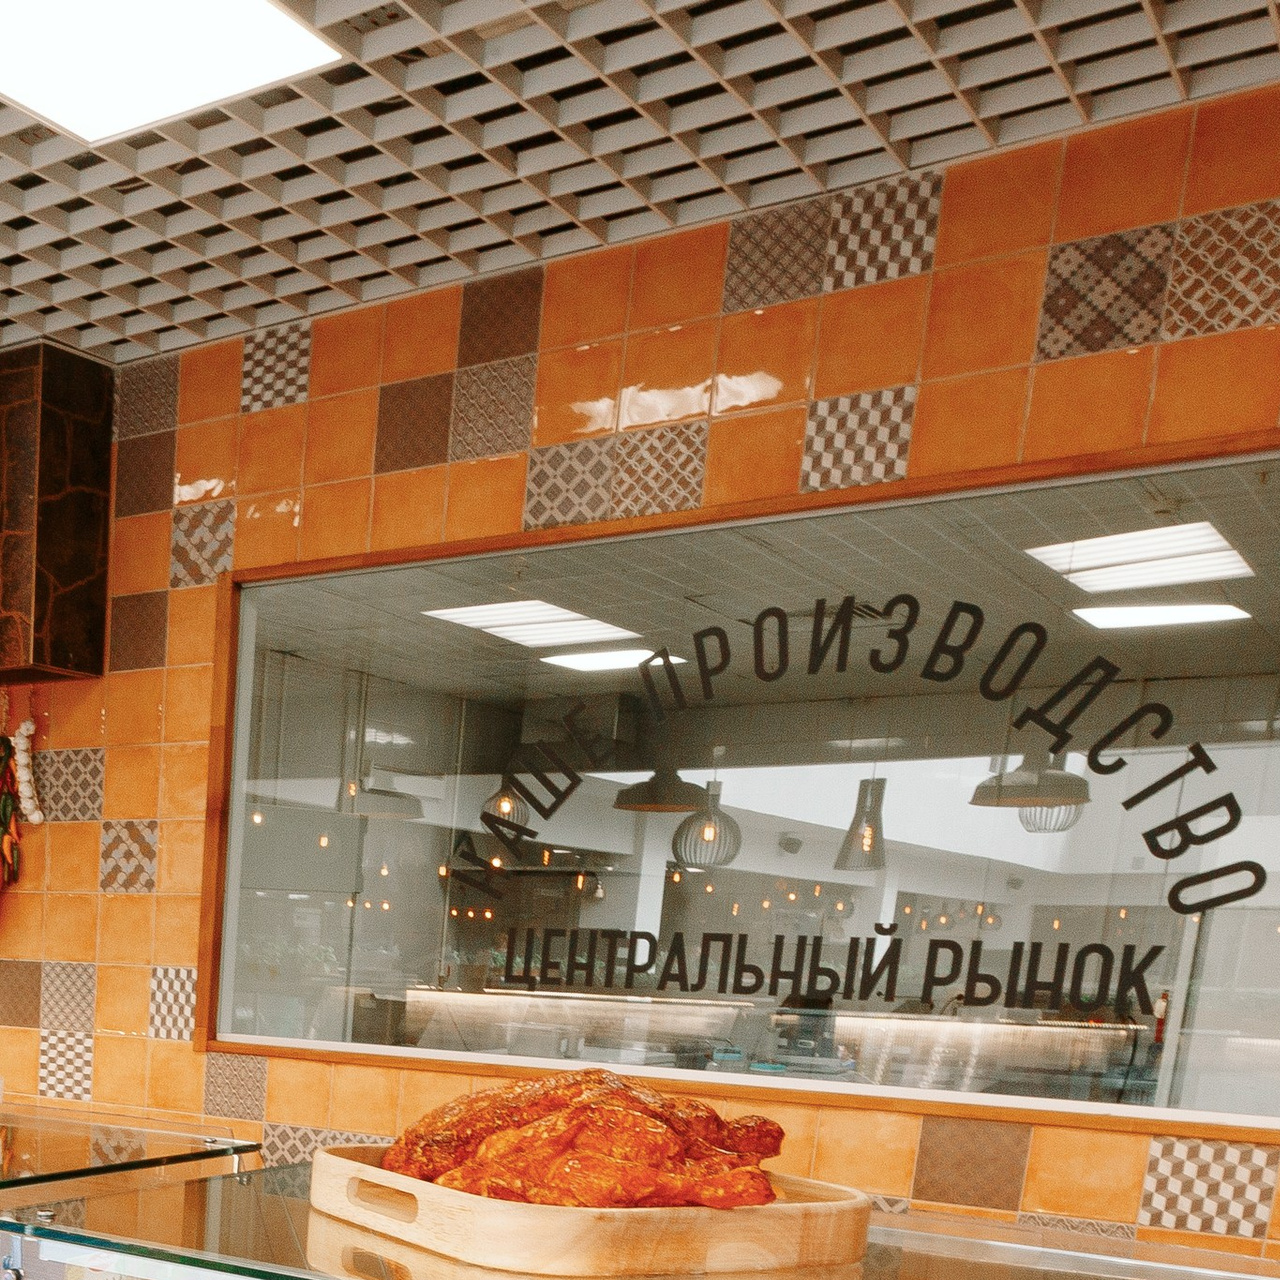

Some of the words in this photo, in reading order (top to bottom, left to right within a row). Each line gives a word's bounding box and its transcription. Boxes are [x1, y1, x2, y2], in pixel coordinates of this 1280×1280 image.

[450, 702, 615, 901] НАШЕ
[640, 594, 1267, 916] ПРОИЗВОДСТВО
[502, 923, 904, 1001] ЦЕНТРАЛЬНЫЙ
[924, 939, 1167, 1016] РЫНОК
